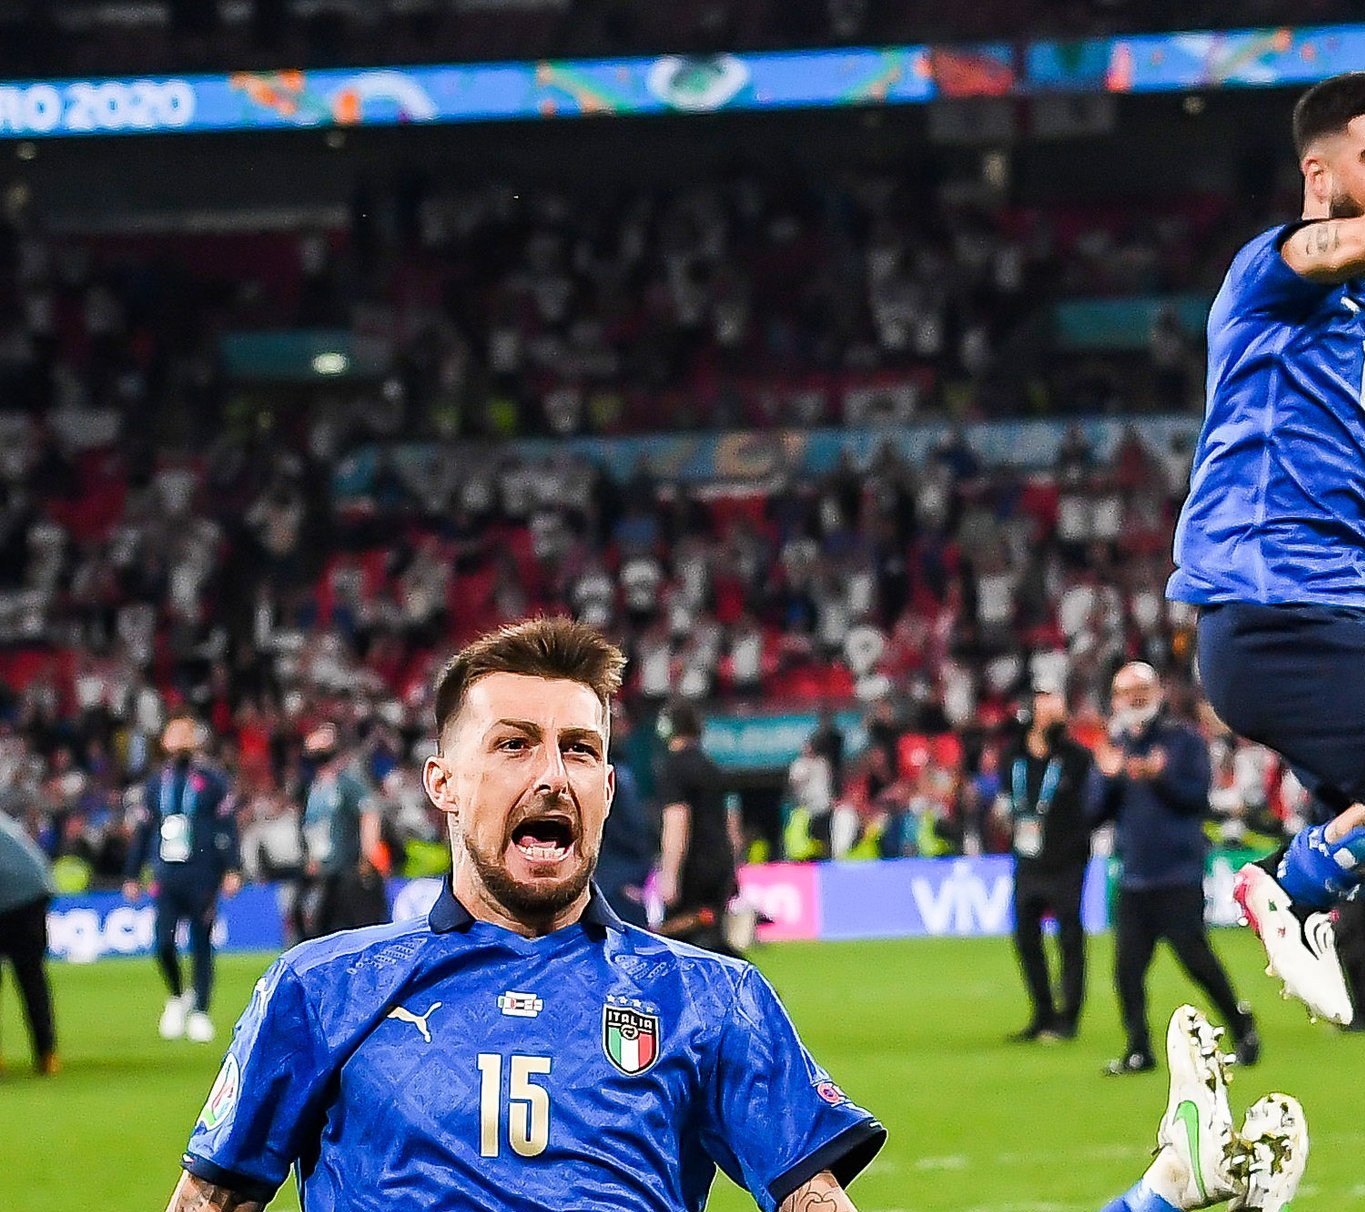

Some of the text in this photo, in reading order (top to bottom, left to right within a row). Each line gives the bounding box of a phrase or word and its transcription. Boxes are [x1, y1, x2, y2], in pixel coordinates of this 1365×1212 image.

[66, 79, 194, 131] 2020
[607, 1010, 654, 1030] ITALIA
[476, 1052, 551, 1158] 15
